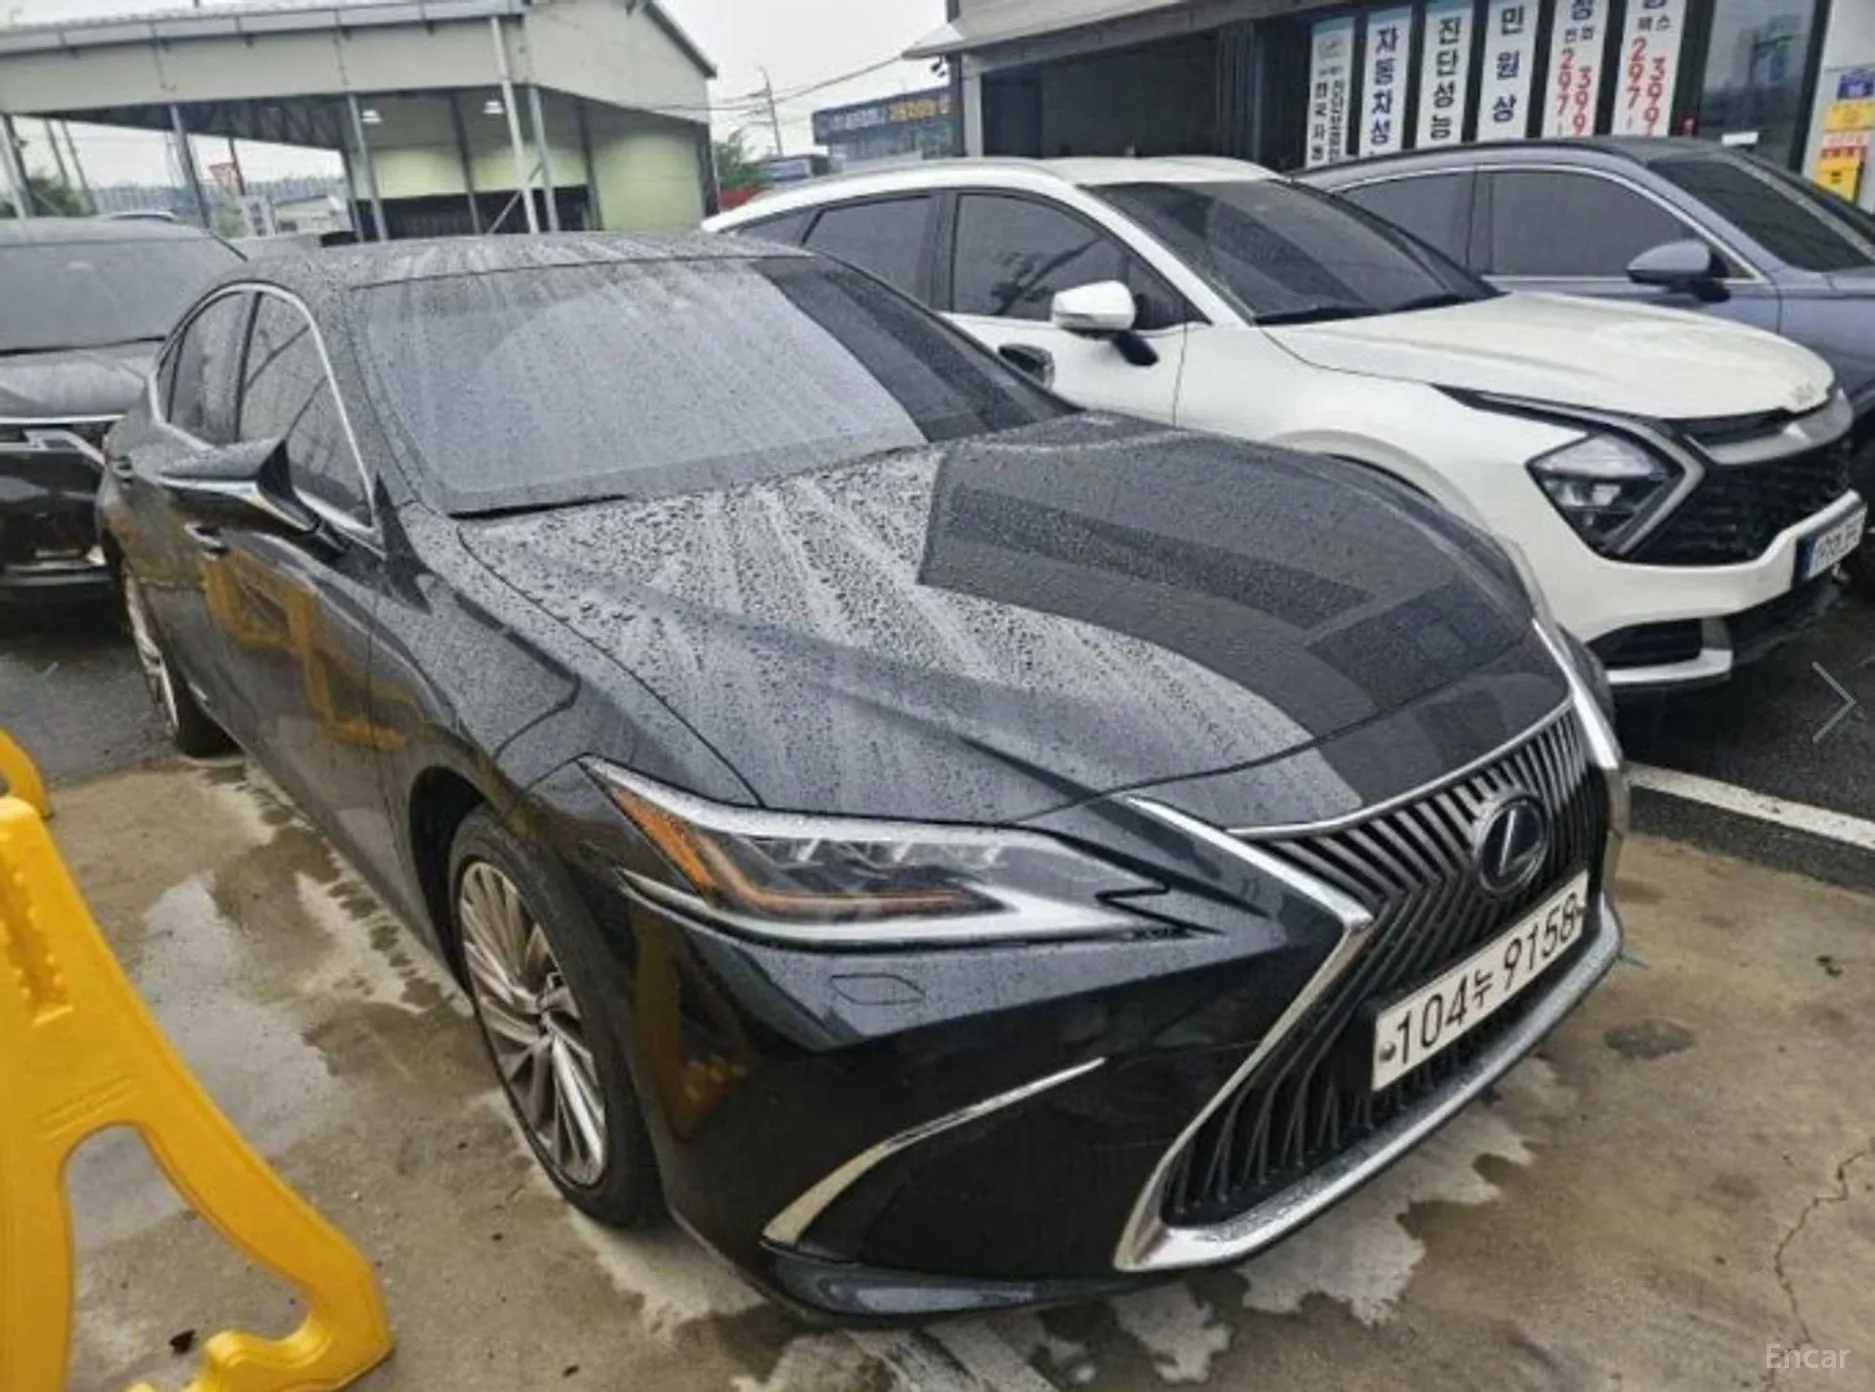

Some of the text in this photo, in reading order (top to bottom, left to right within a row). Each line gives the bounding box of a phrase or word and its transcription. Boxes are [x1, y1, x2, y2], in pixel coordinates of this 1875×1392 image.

[1370, 25, 1399, 155] 자동차성
[1430, 16, 1461, 140] 진단성능
[1397, 892, 1578, 1065] 104누 9158
